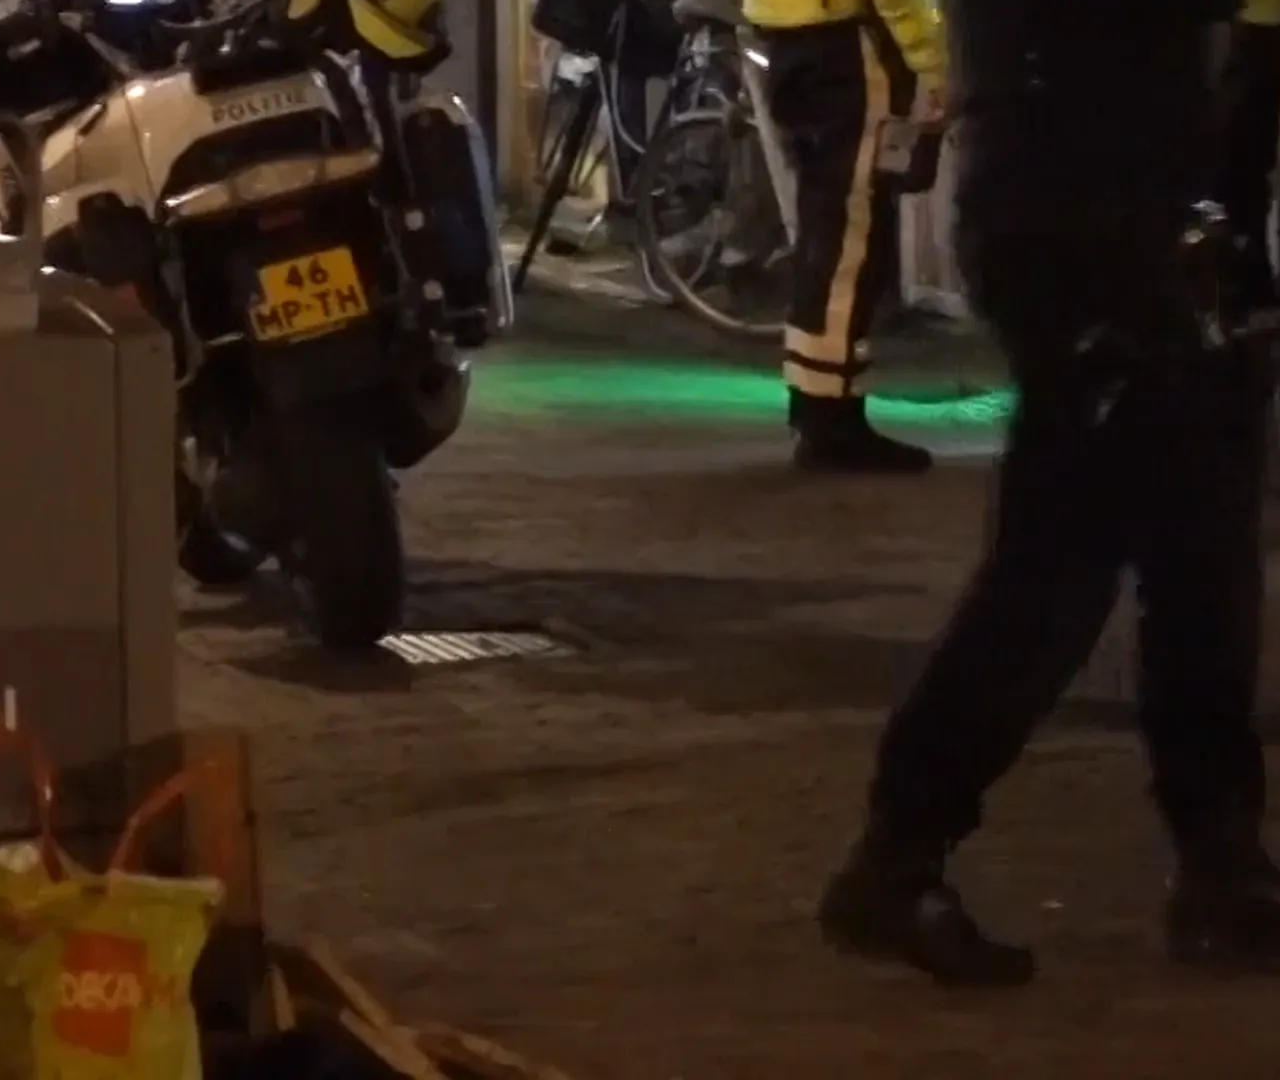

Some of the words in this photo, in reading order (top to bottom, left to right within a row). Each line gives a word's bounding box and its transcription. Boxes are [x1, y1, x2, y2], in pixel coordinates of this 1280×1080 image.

[211, 88, 310, 124] POLITIE
[283, 259, 329, 288] 46
[253, 283, 362, 334] MP-TH
